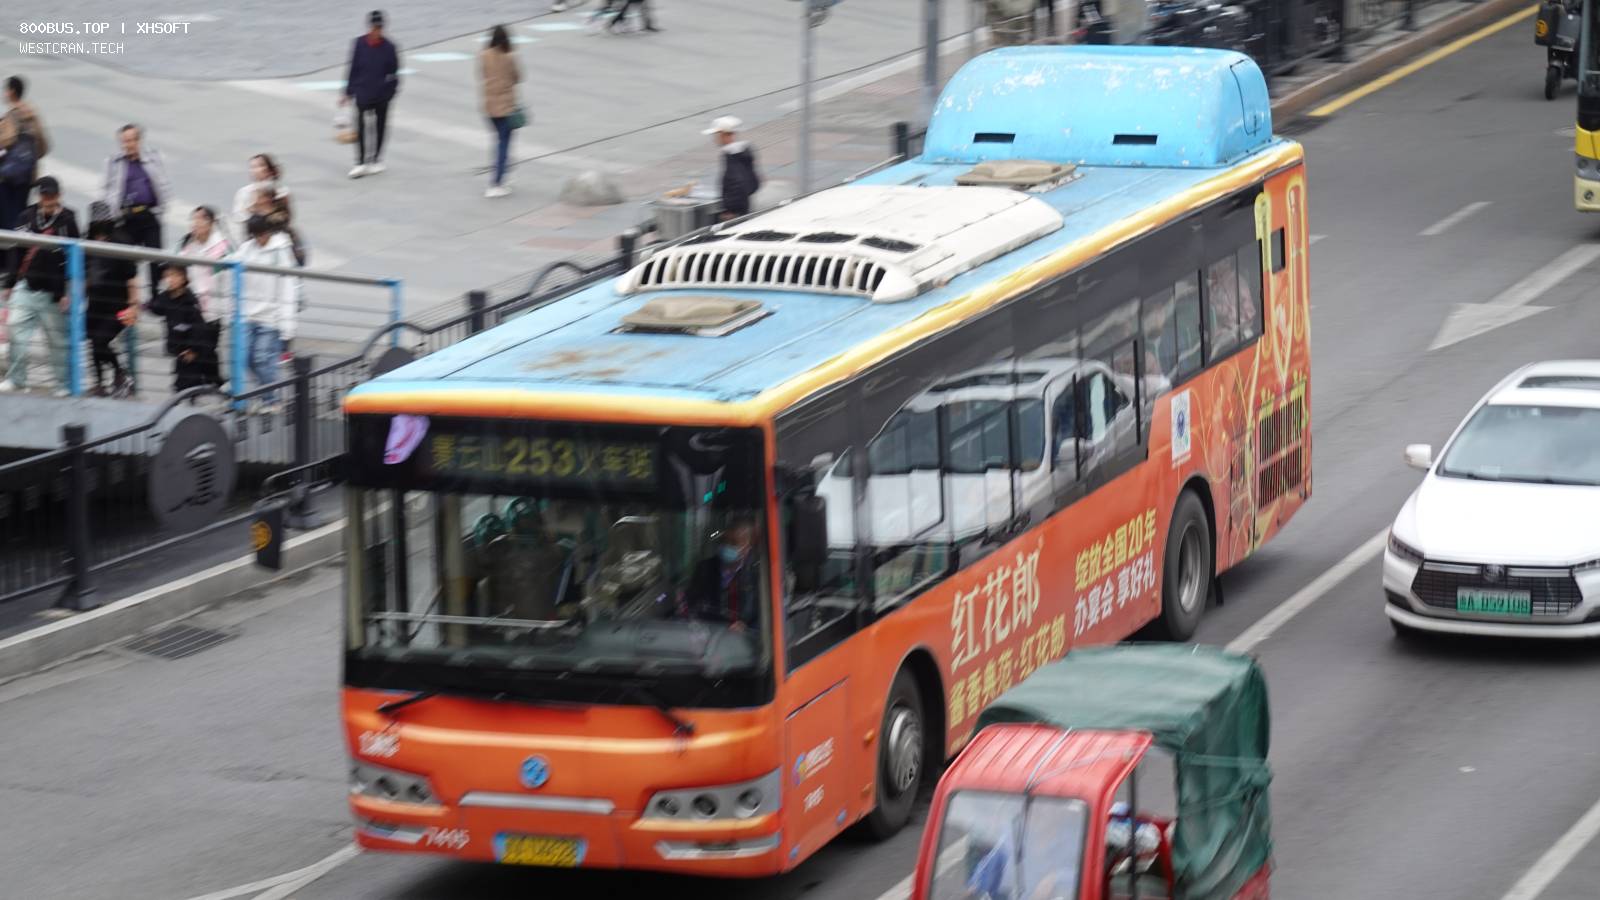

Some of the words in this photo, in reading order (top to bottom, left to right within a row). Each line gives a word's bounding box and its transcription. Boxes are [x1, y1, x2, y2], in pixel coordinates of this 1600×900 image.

[503, 436, 574, 477] 253
[1074, 507, 1157, 592] 绽放全国20年
[950, 548, 1041, 674] 红花郎
